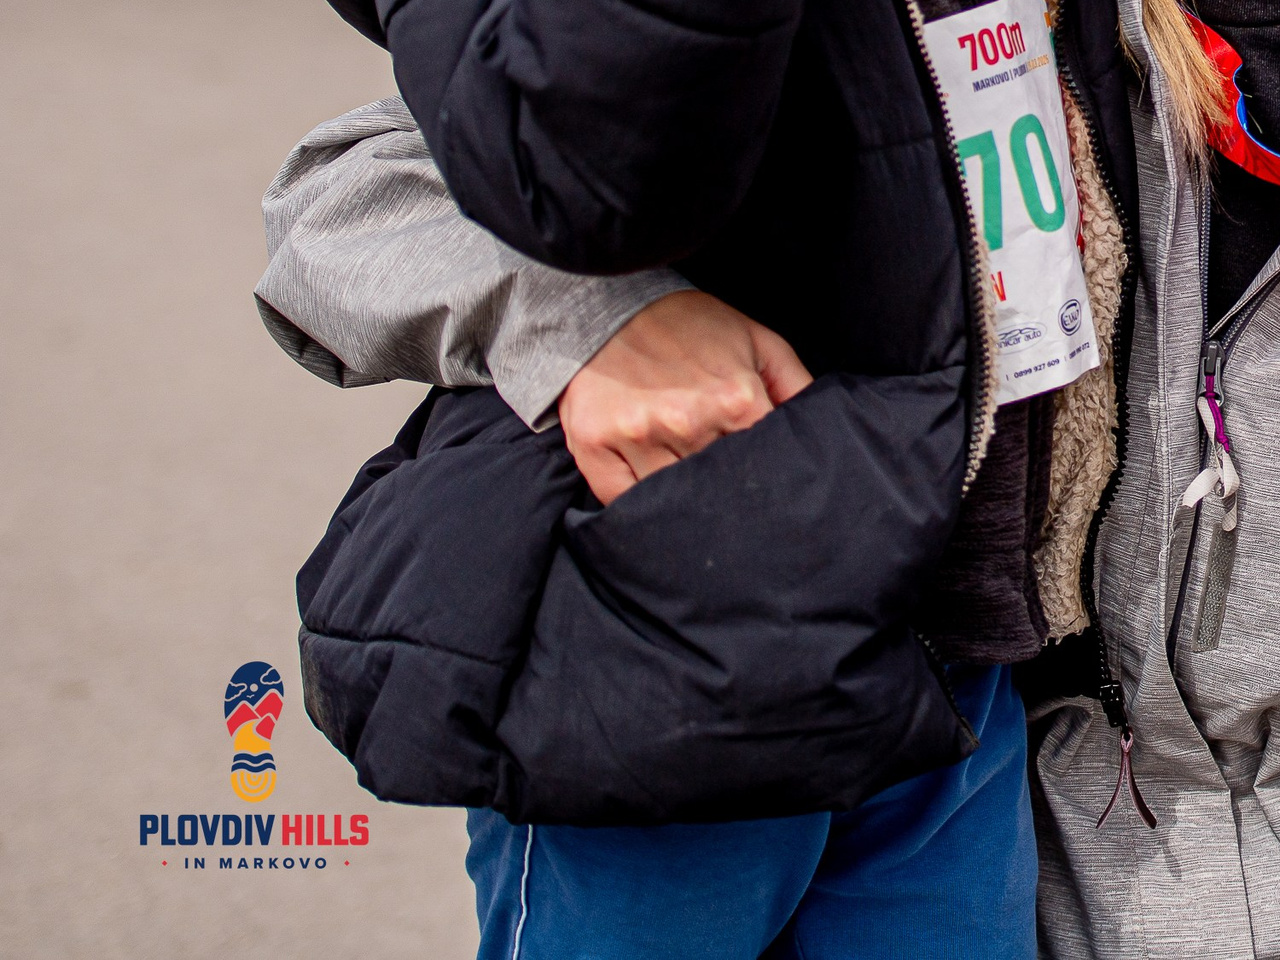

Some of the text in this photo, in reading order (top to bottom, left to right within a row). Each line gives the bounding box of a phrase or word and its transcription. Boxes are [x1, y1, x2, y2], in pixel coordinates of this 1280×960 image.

[958, 22, 1026, 71] 700m
[972, 71, 1010, 93] MARKOVO
[957, 113, 1066, 252] 70
[1033, 362, 1046, 373] 927
[1046, 357, 1060, 369] 609
